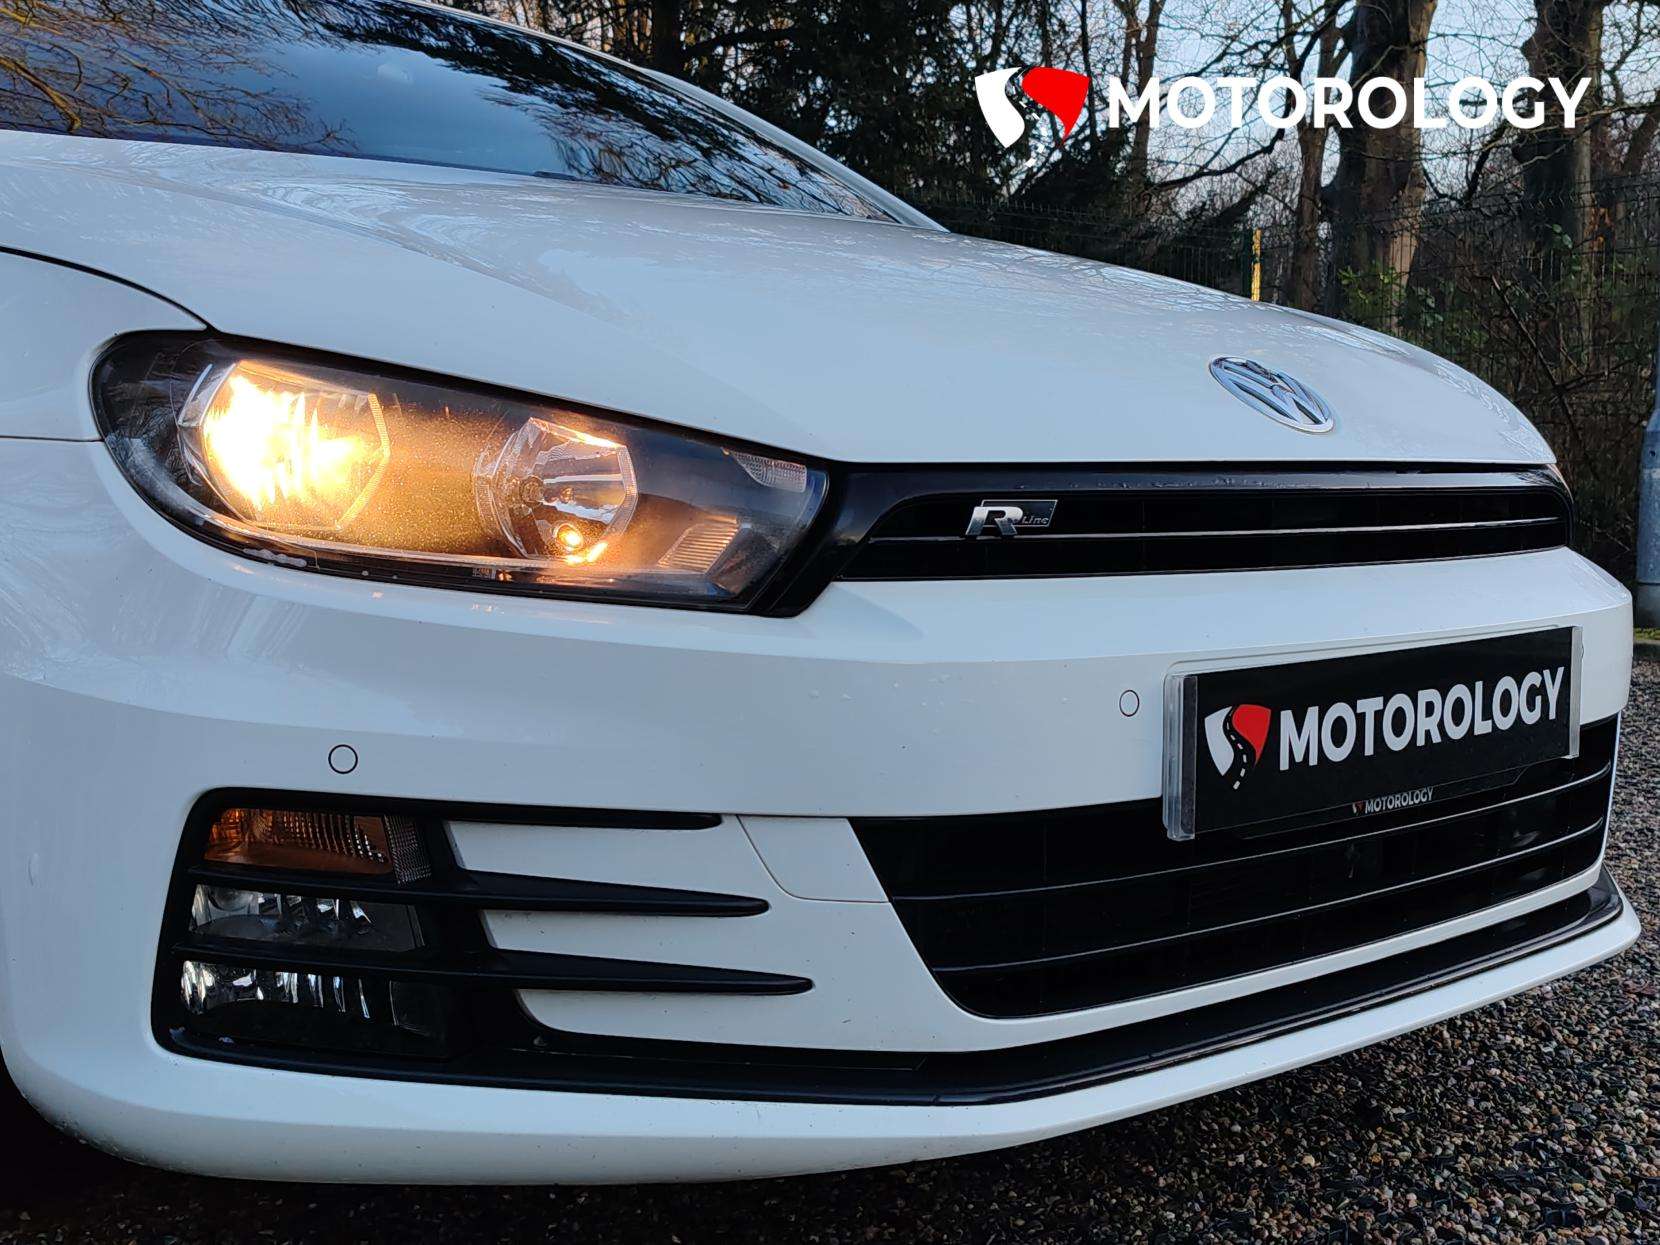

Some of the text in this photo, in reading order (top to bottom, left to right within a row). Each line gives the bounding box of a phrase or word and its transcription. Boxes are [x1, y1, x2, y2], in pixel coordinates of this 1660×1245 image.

[966, 506, 1023, 535] R
[1279, 667, 1565, 771] MOTOROLOGY
[1365, 786, 1434, 814] MOTOROLOGY
